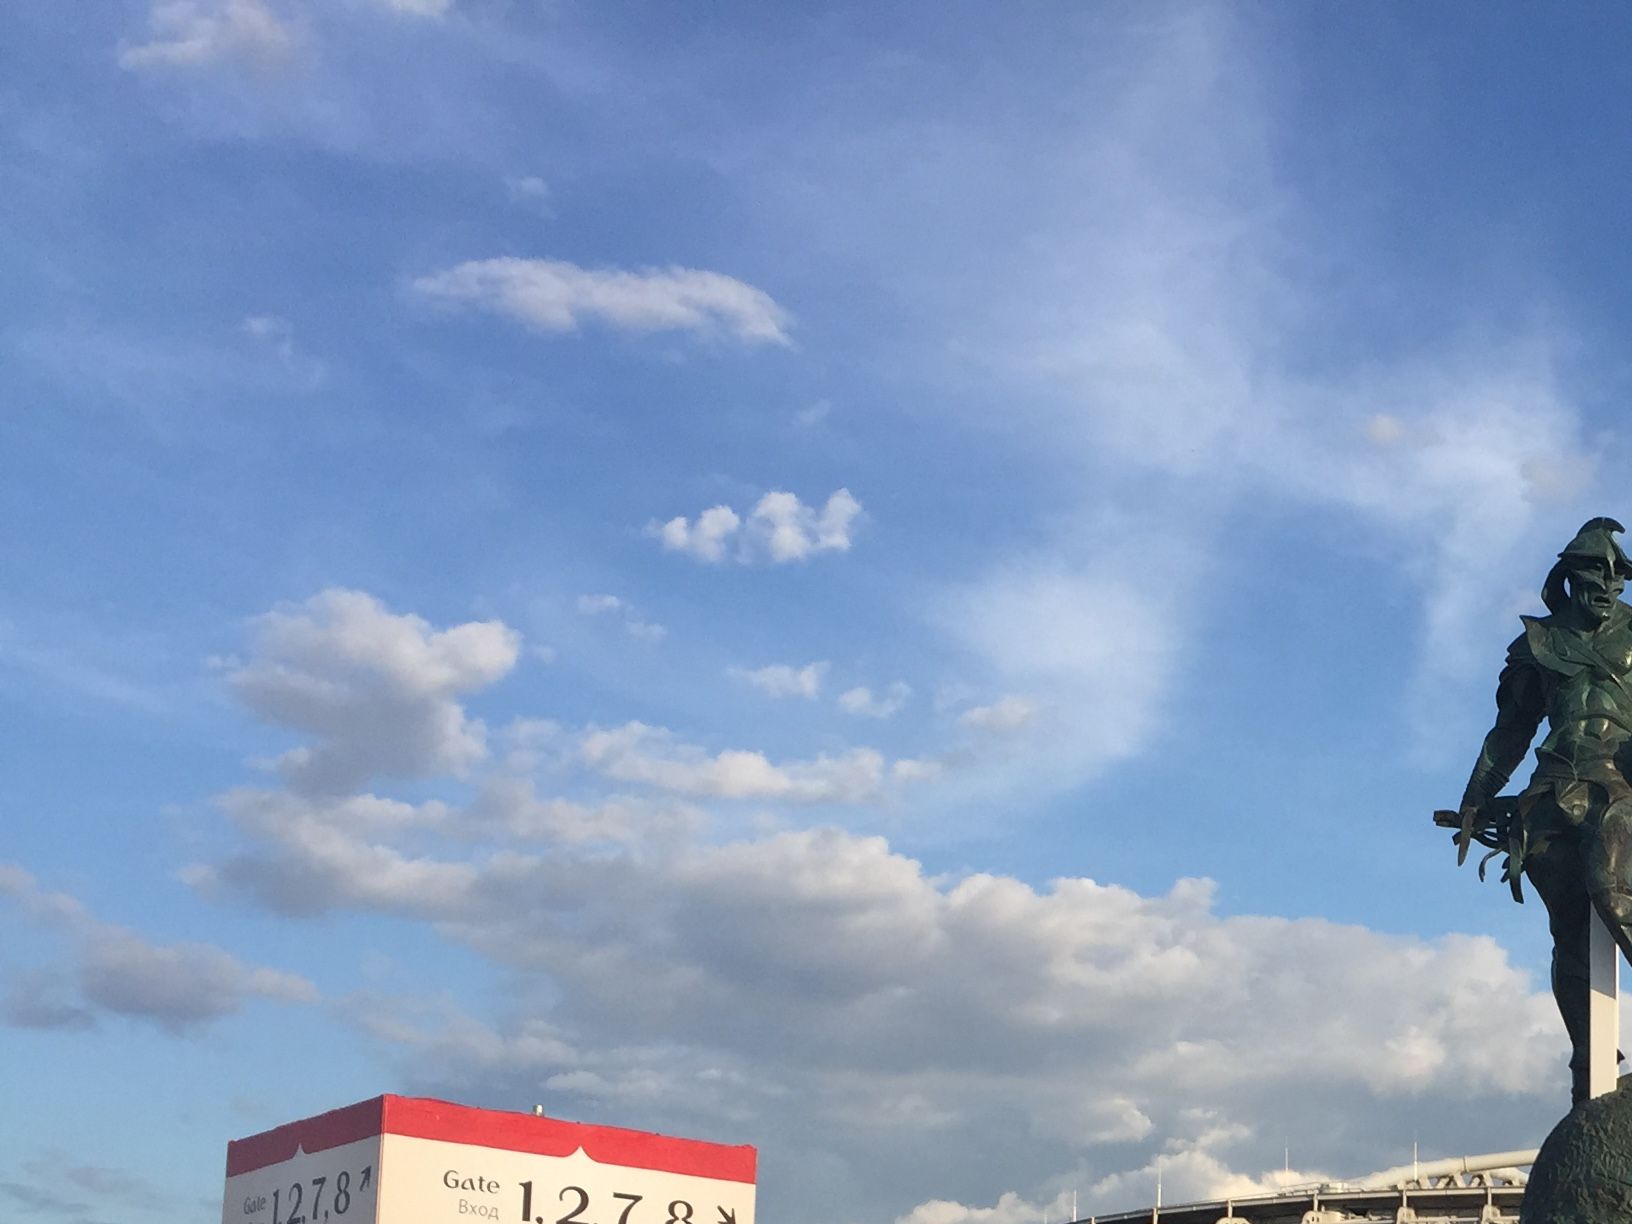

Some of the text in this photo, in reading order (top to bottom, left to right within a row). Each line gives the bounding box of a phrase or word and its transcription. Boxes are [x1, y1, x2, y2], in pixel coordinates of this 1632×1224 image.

[444, 1170, 500, 1195] Gate
[244, 1196, 266, 1215] Gate
[458, 1198, 500, 1221] Вход
